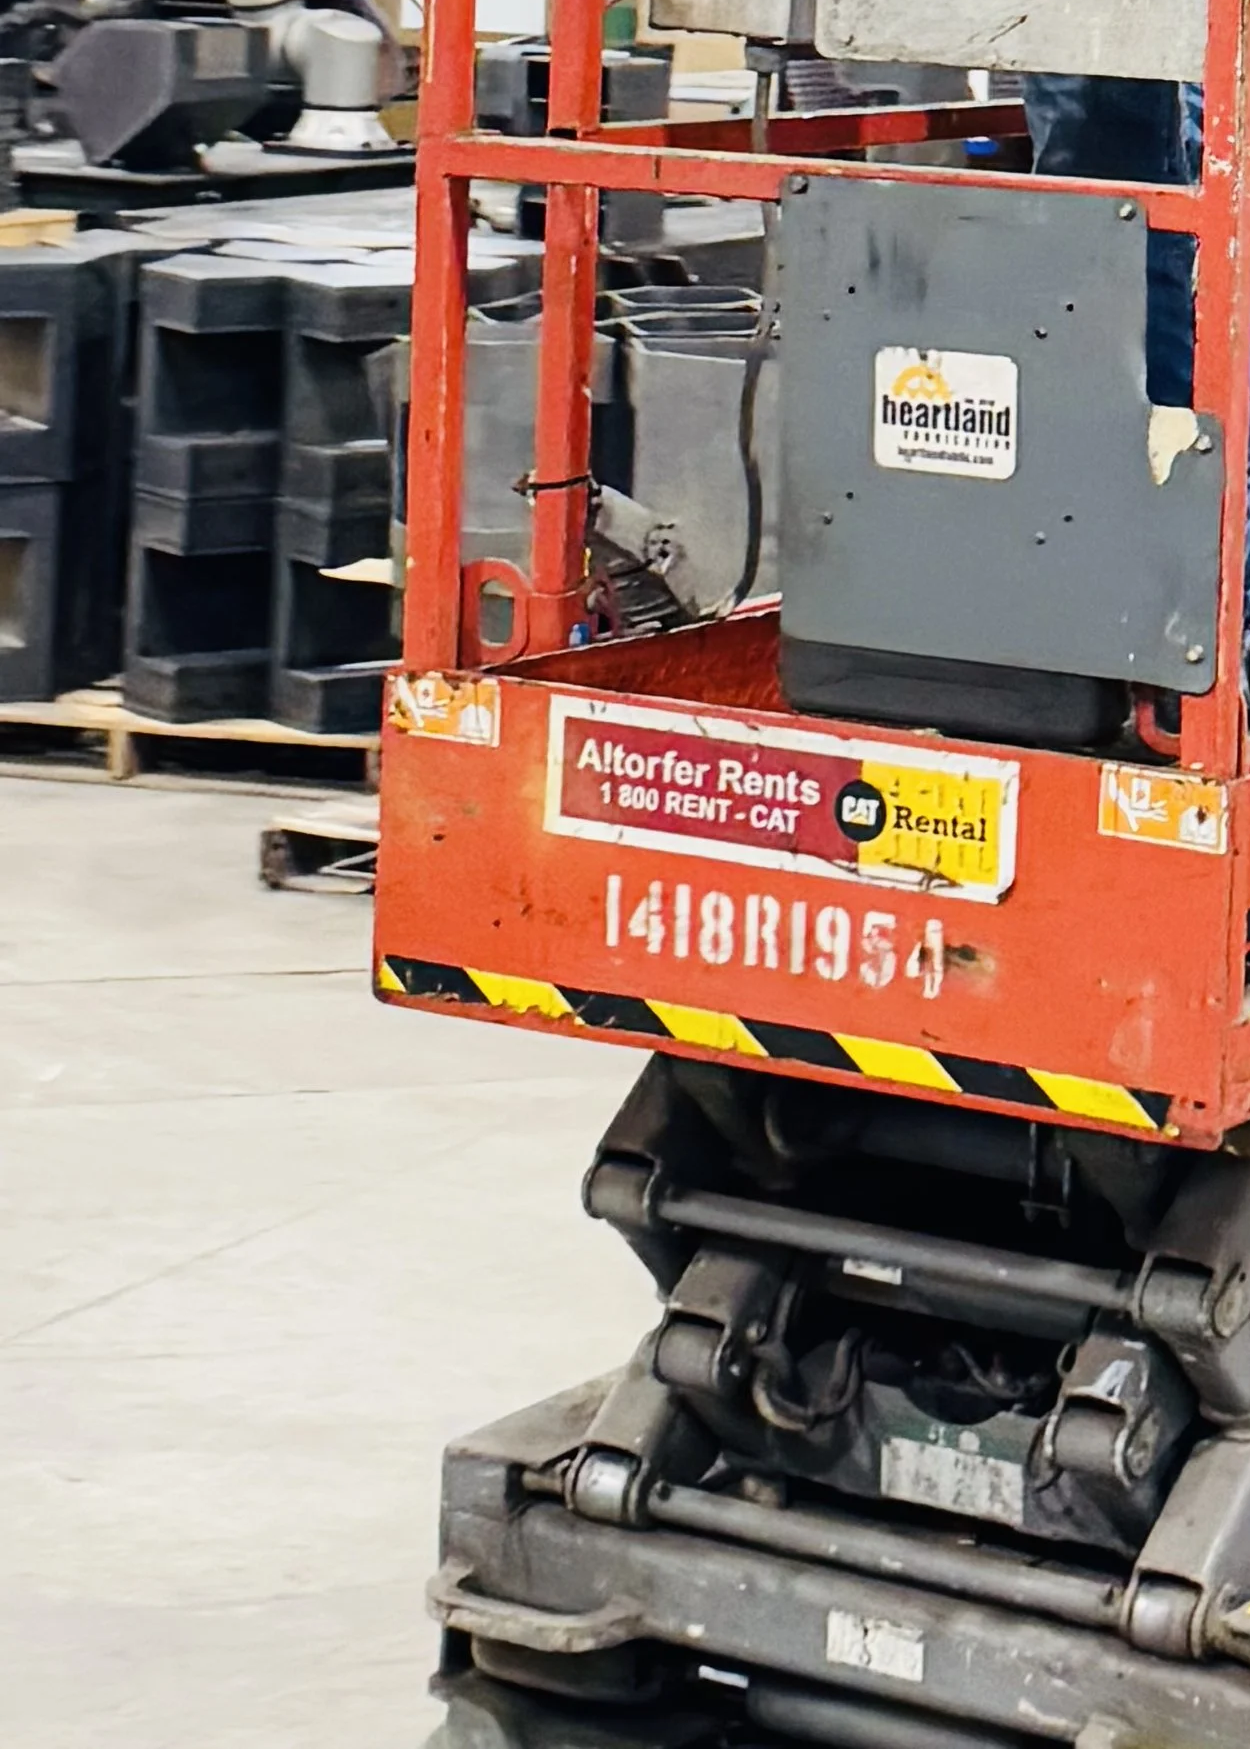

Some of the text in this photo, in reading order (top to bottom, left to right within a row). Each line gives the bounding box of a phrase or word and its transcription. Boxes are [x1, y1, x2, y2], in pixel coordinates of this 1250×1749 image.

[882, 394, 1010, 437] heartland
[577, 738, 821, 806] Altorfer Rents
[618, 783, 659, 811] 800
[664, 791, 734, 823] RENT
[749, 805, 800, 834] CAT
[892, 805, 988, 842] Rental
[605, 874, 945, 1000] 1418R1954
